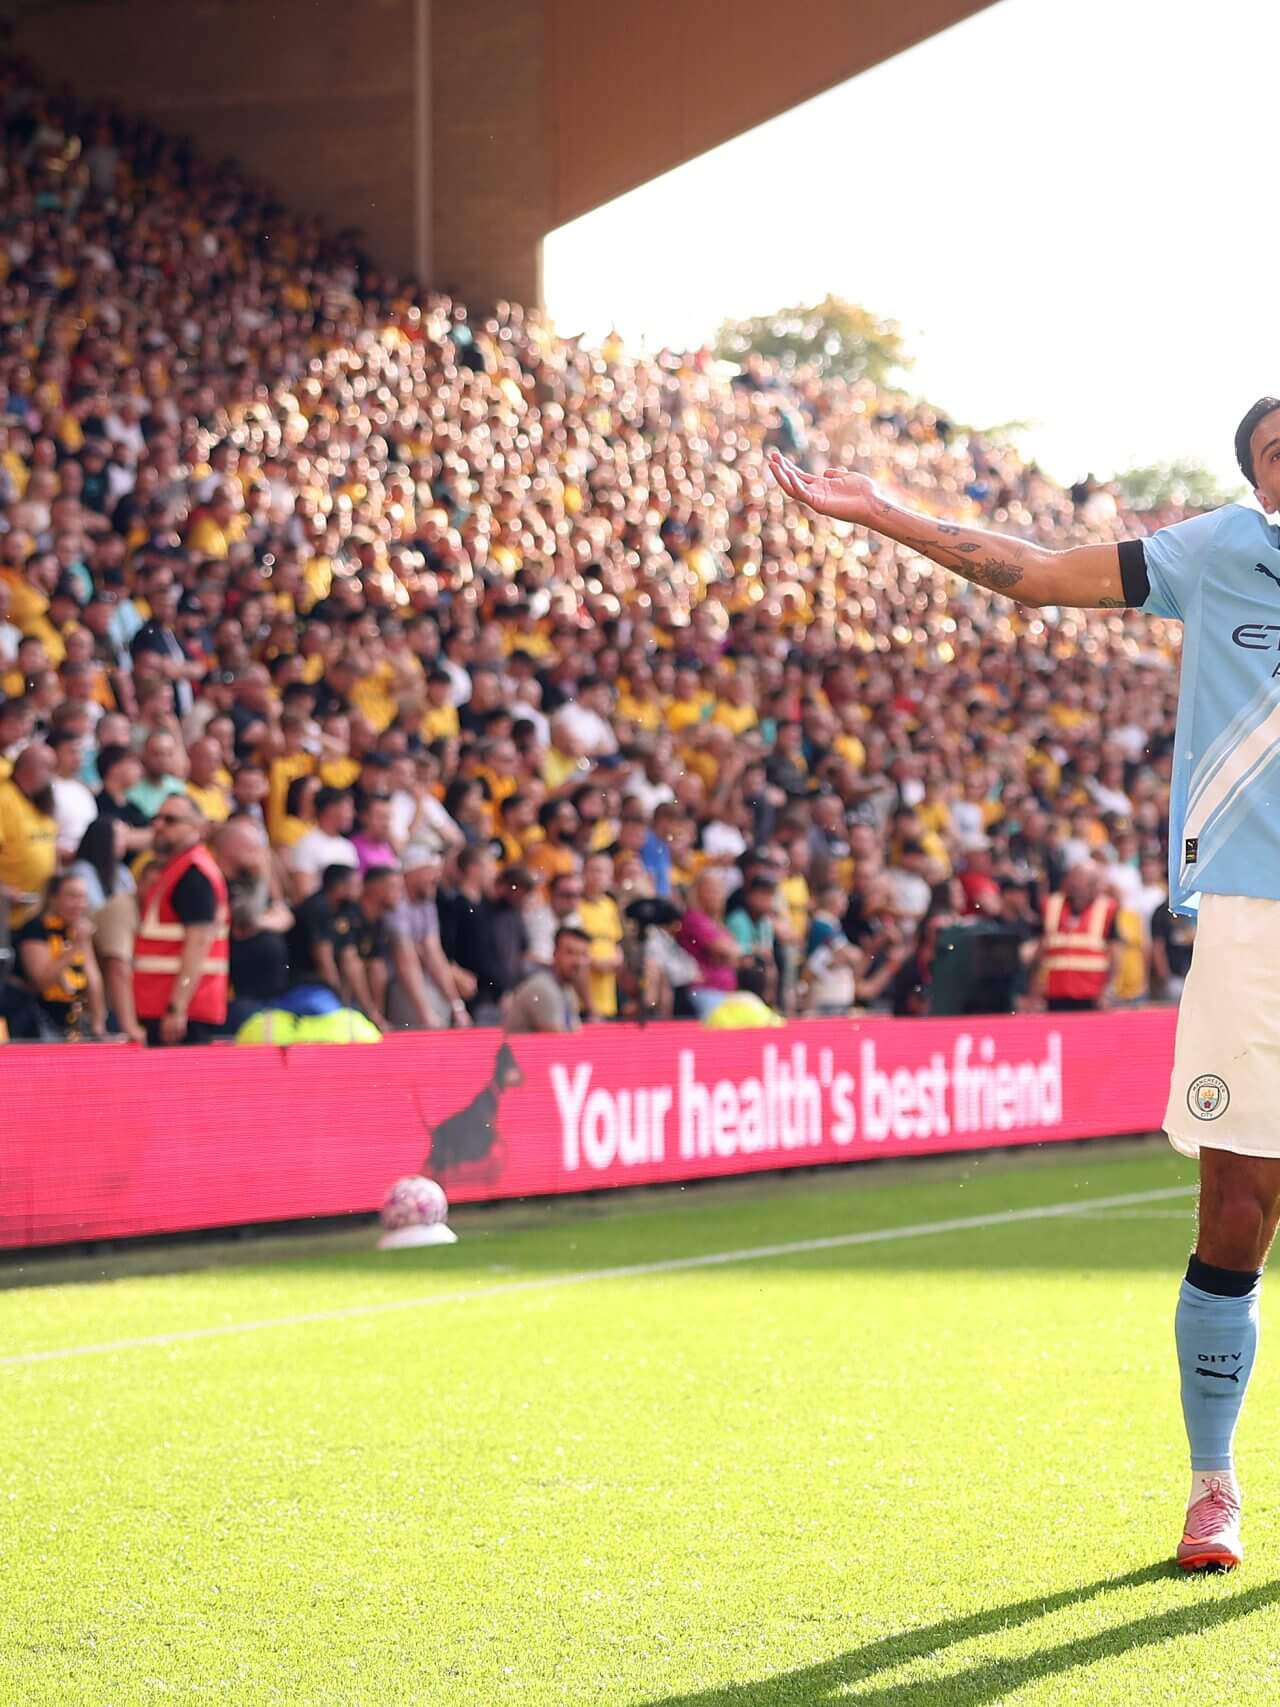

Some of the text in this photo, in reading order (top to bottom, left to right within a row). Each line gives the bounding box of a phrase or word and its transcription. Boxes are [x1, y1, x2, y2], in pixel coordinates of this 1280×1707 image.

[550, 1030, 1063, 1171] Your health's best friend
